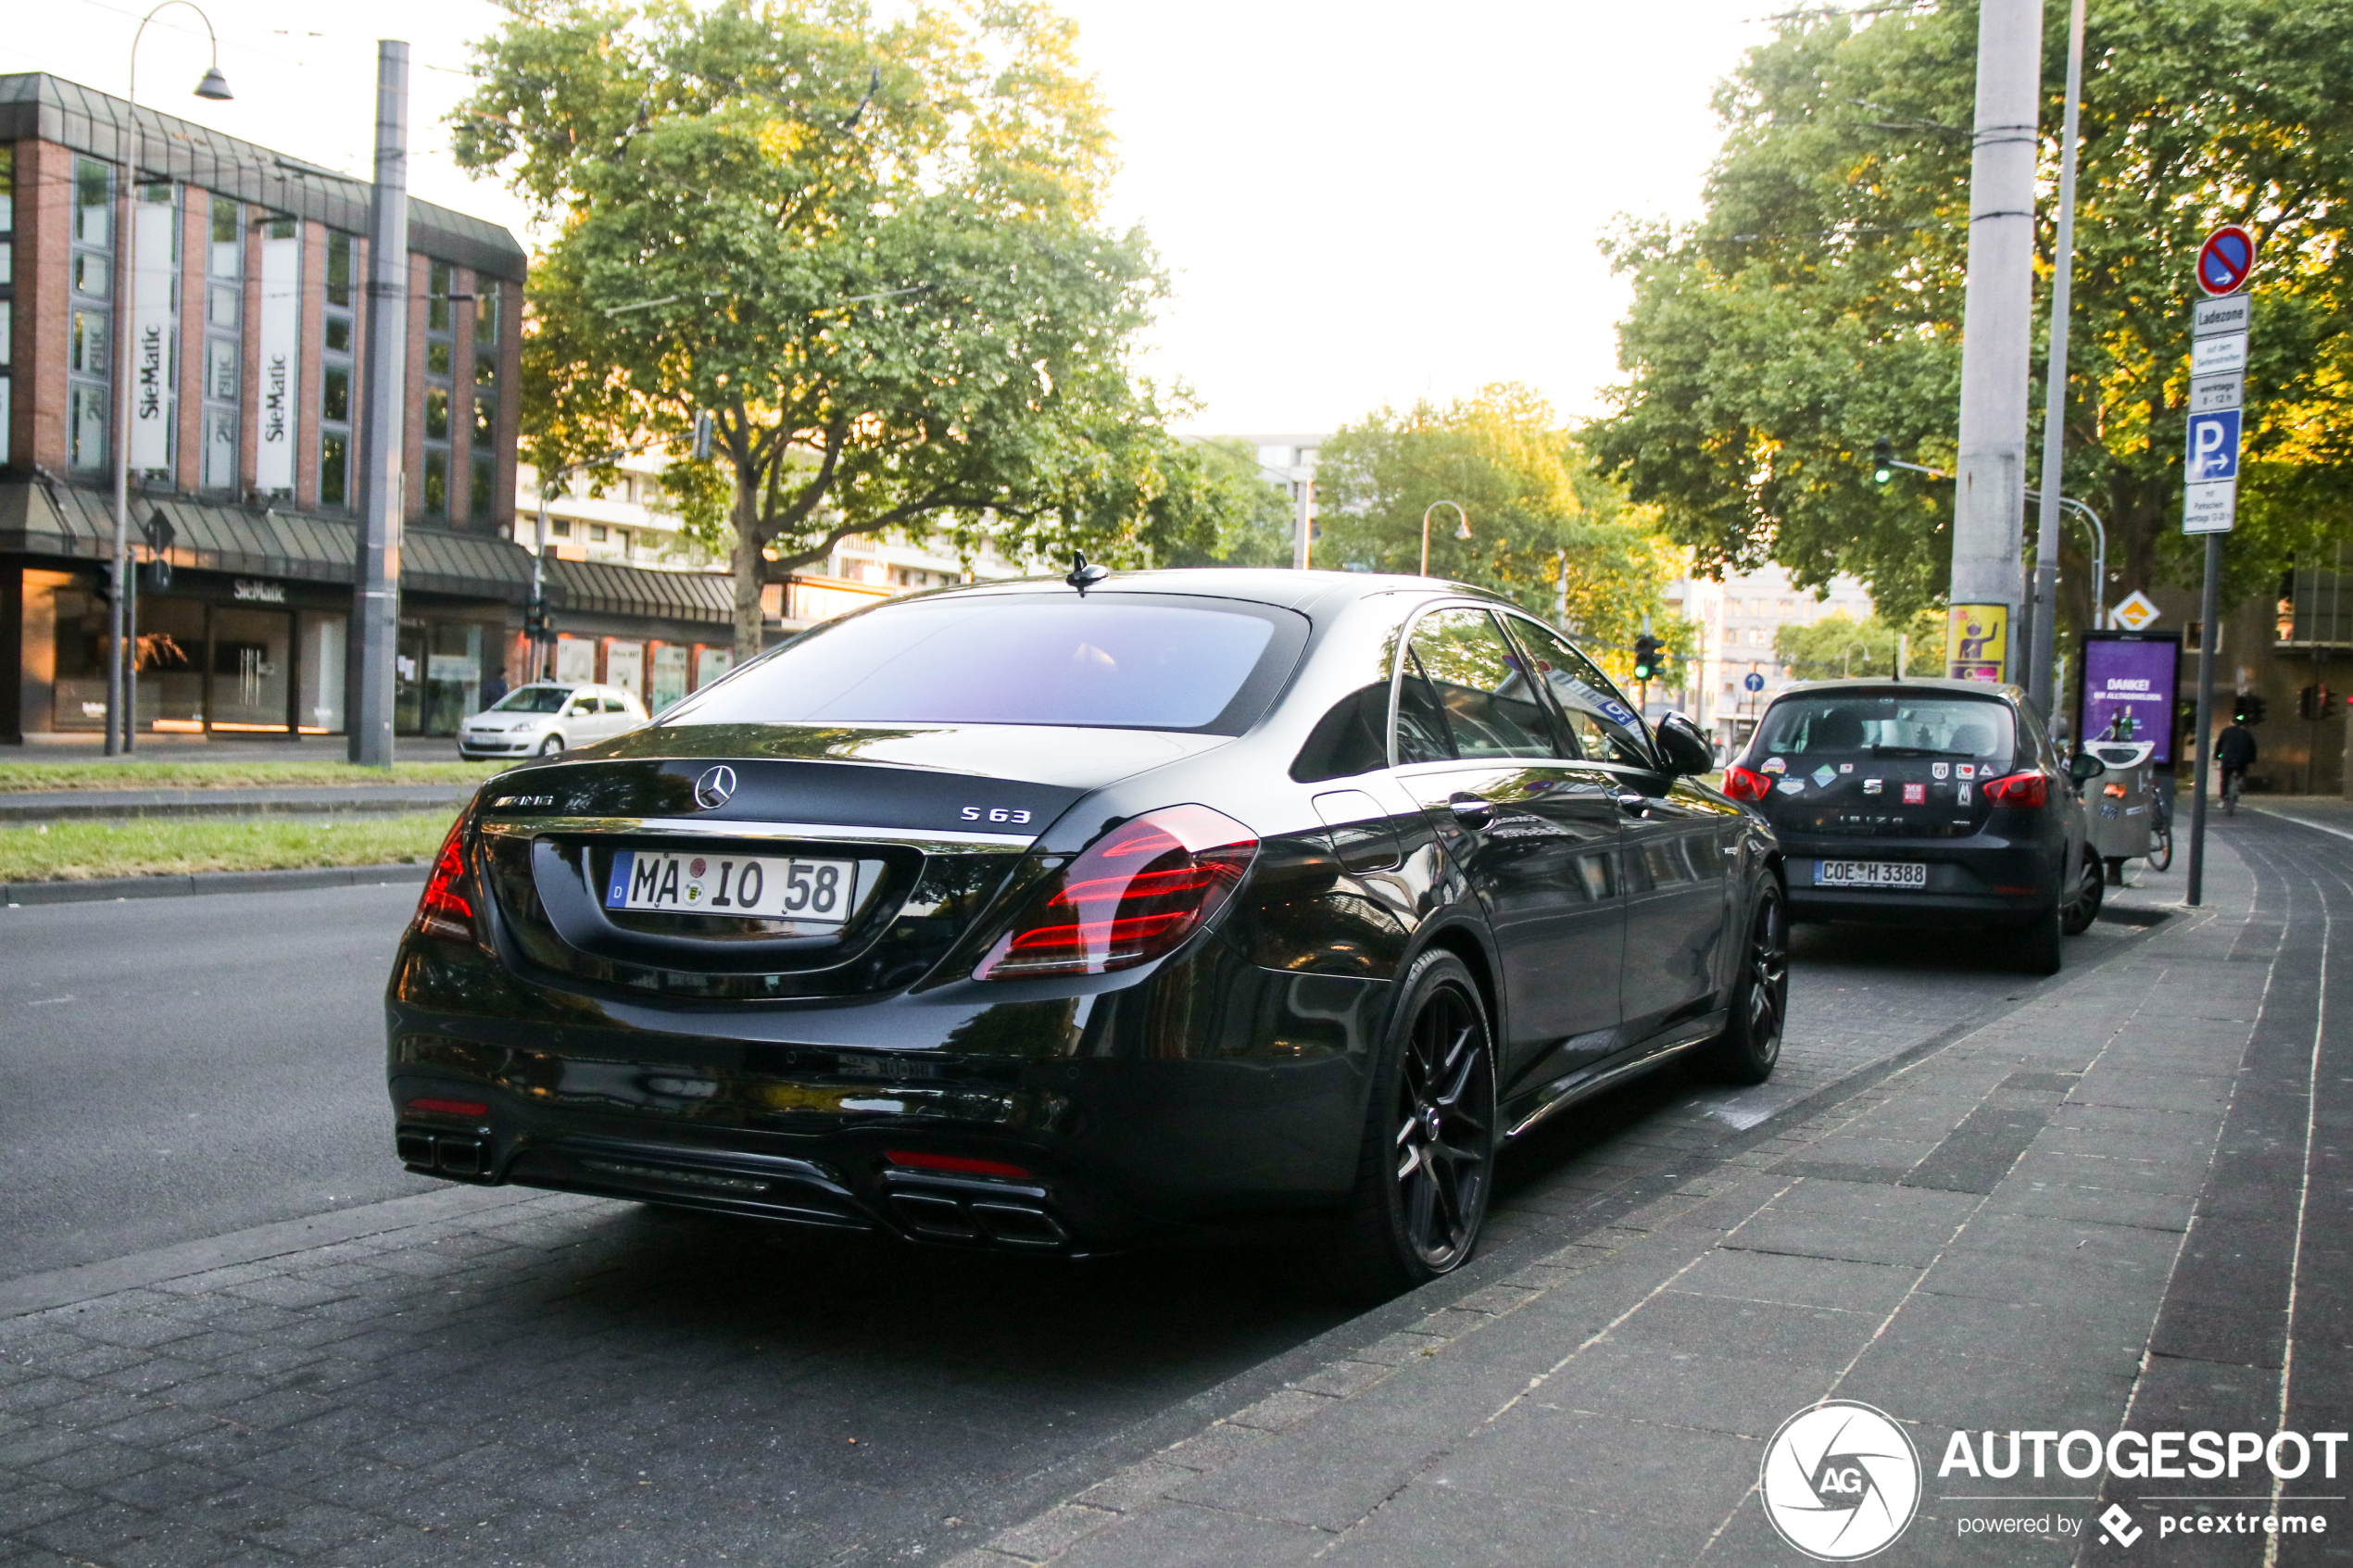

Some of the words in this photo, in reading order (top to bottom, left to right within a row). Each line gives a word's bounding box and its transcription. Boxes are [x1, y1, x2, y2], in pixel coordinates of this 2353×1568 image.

[2198, 308, 2244, 326] Ladezone
[139, 324, 160, 420] SieMatic
[265, 353, 285, 442] SieMatic
[2199, 383, 2235, 394] werktags
[2215, 395, 2224, 404] 12
[2194, 420, 2223, 472] P
[233, 579, 285, 602] SieMatic
[2107, 678, 2150, 692] DANKE!
[961, 806, 981, 821] S
[988, 808, 1031, 824] 63
[1823, 862, 1855, 880] COE
[1867, 863, 1879, 881] H
[1882, 864, 1924, 883] 3388
[612, 885, 623, 898] D
[632, 858, 679, 903] MA
[711, 861, 763, 909] IO
[785, 864, 838, 912] 58
